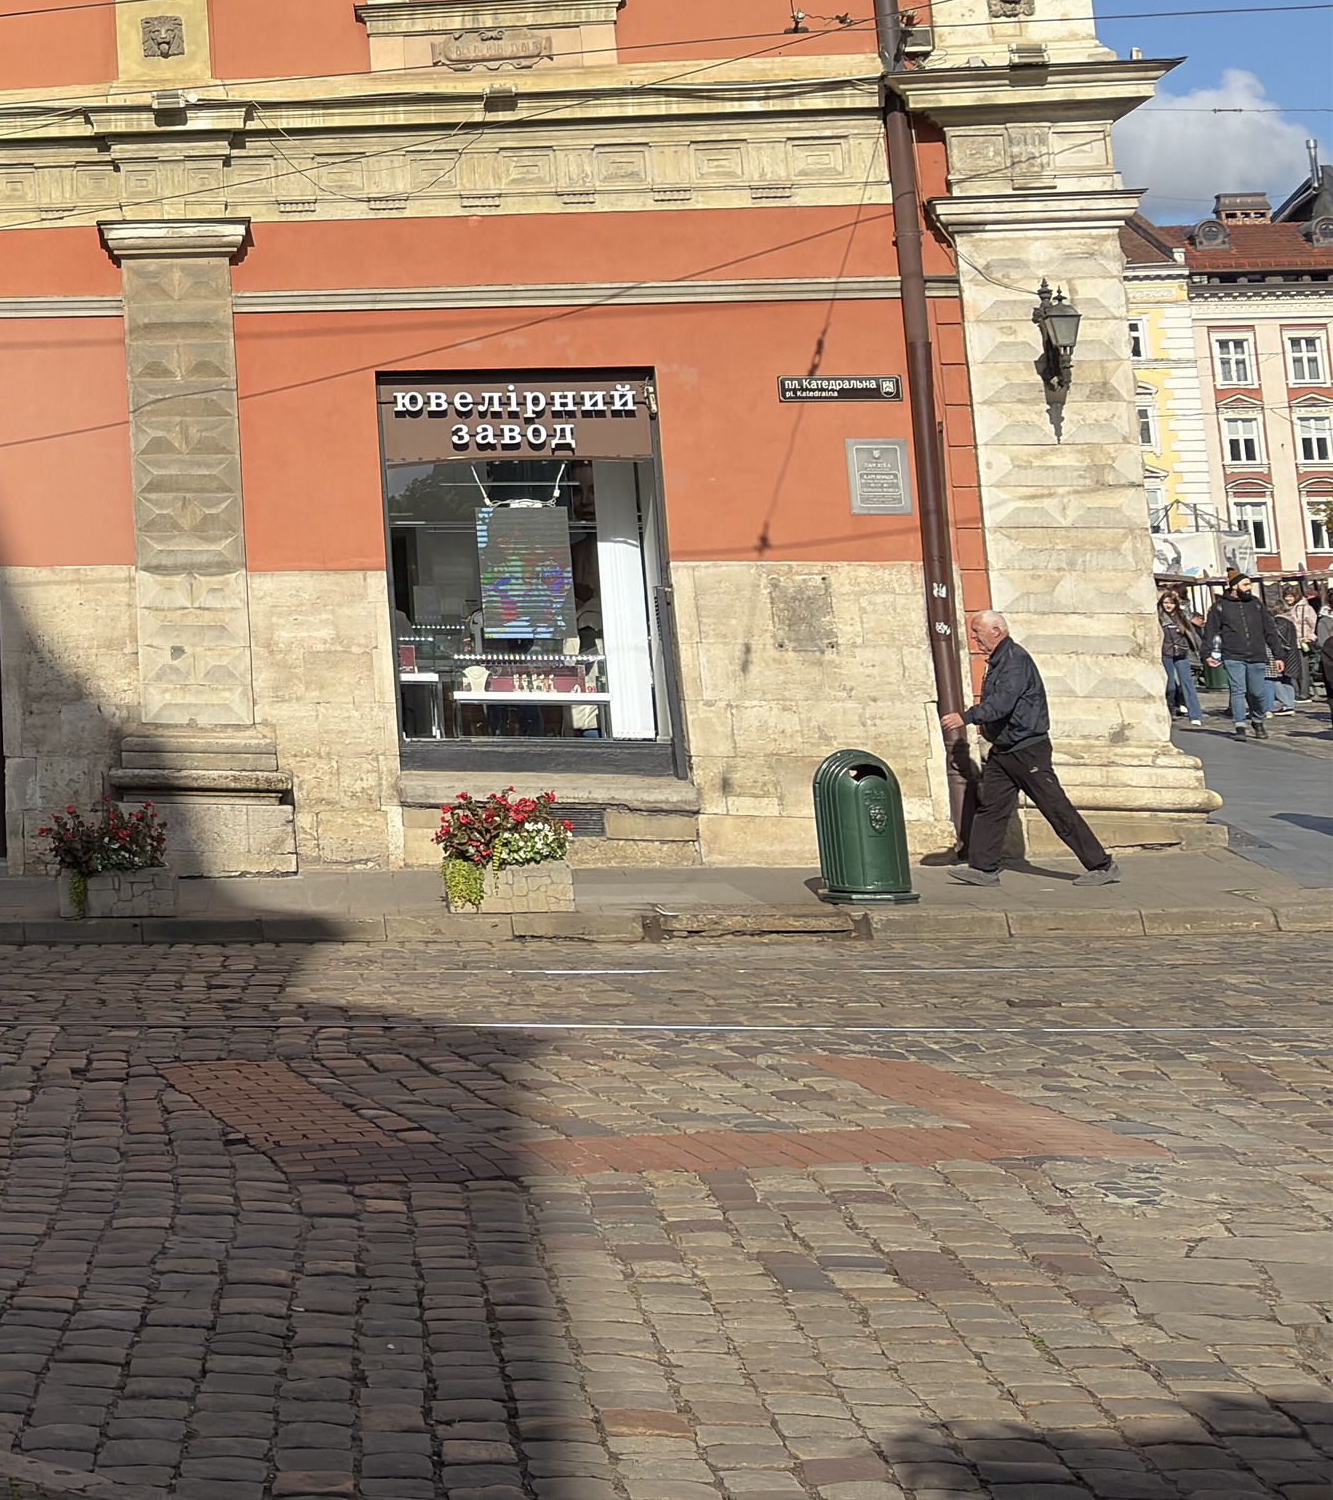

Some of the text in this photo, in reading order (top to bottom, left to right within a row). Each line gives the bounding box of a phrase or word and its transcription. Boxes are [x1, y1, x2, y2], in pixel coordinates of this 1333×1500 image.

[785, 379, 877, 390] пл. Катедральна
[393, 384, 637, 417] ювелірний
[451, 423, 576, 448] завод
